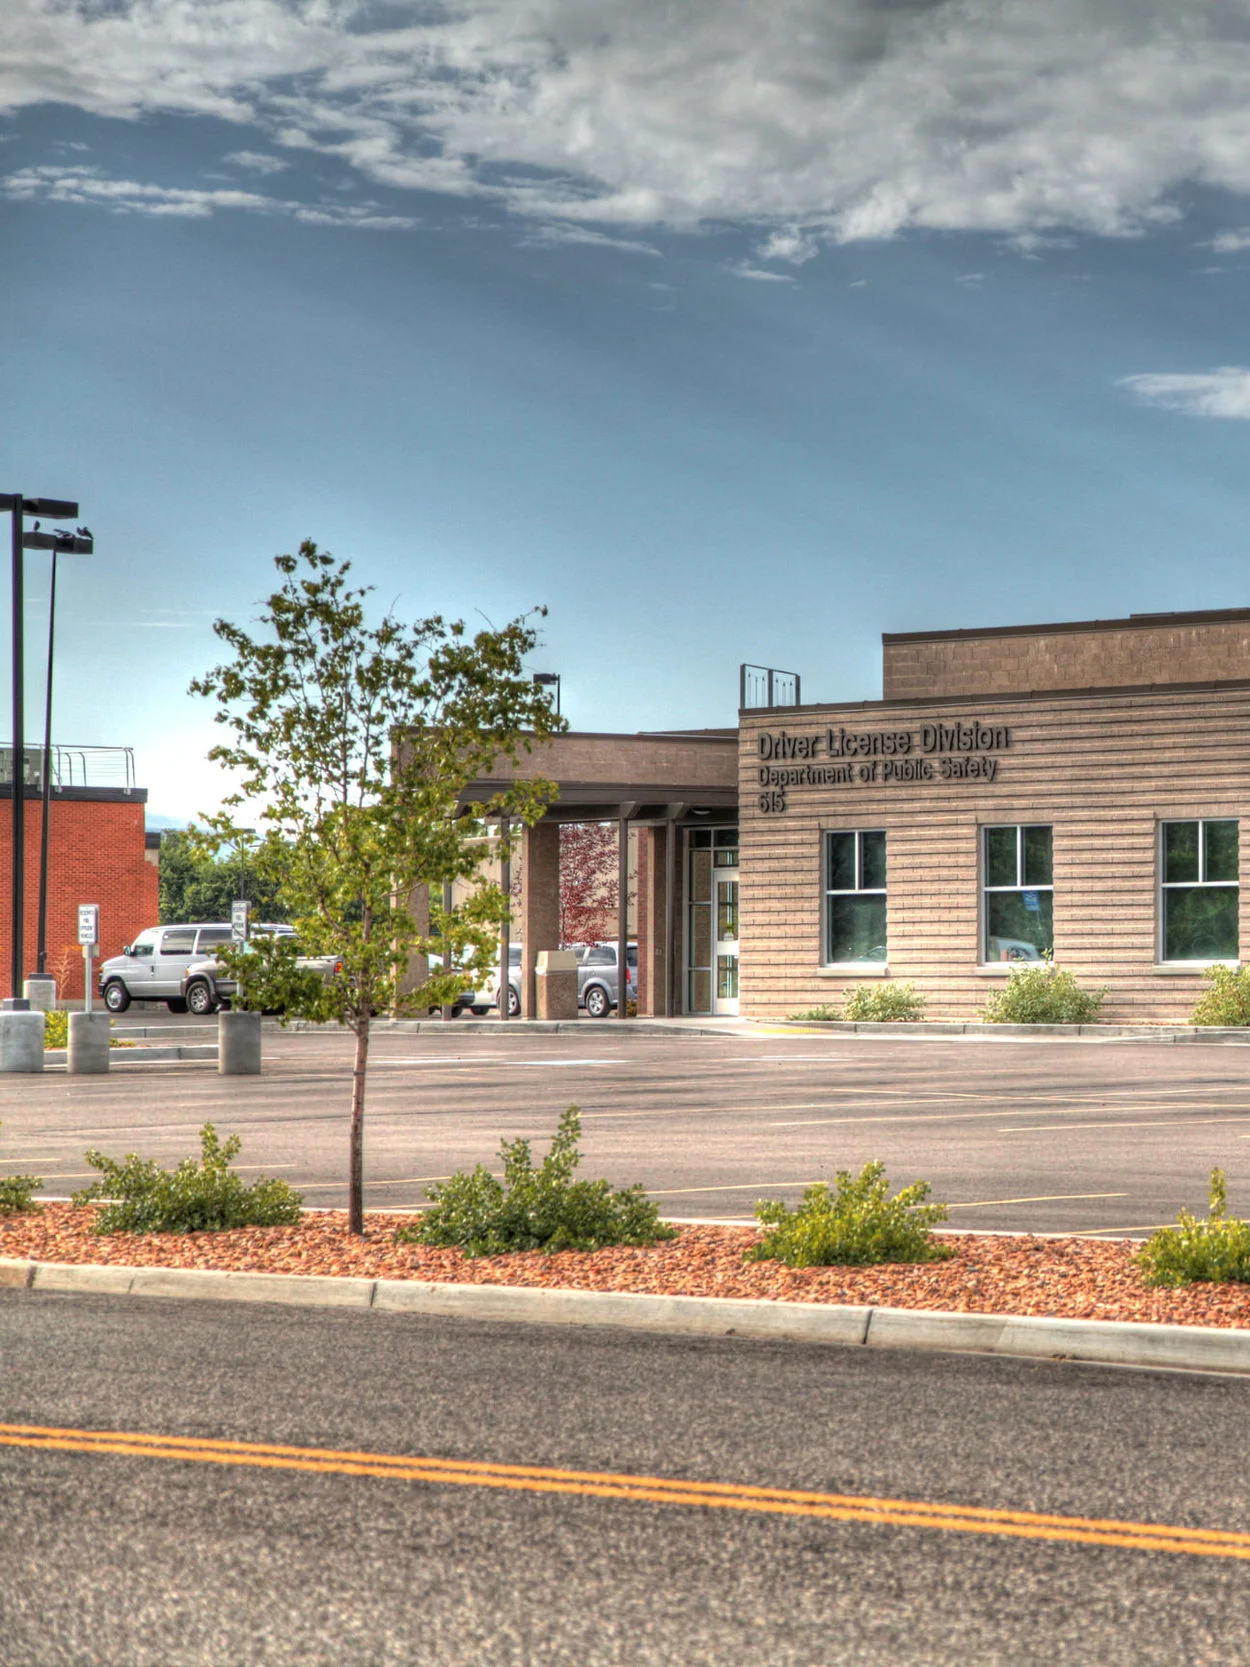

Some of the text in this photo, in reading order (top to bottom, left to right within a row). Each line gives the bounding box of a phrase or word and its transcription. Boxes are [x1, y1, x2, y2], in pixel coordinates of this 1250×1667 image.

[758, 720, 1010, 760] Driver License Division
[758, 757, 998, 790] Department of Public Safety
[758, 791, 786, 813] 615
